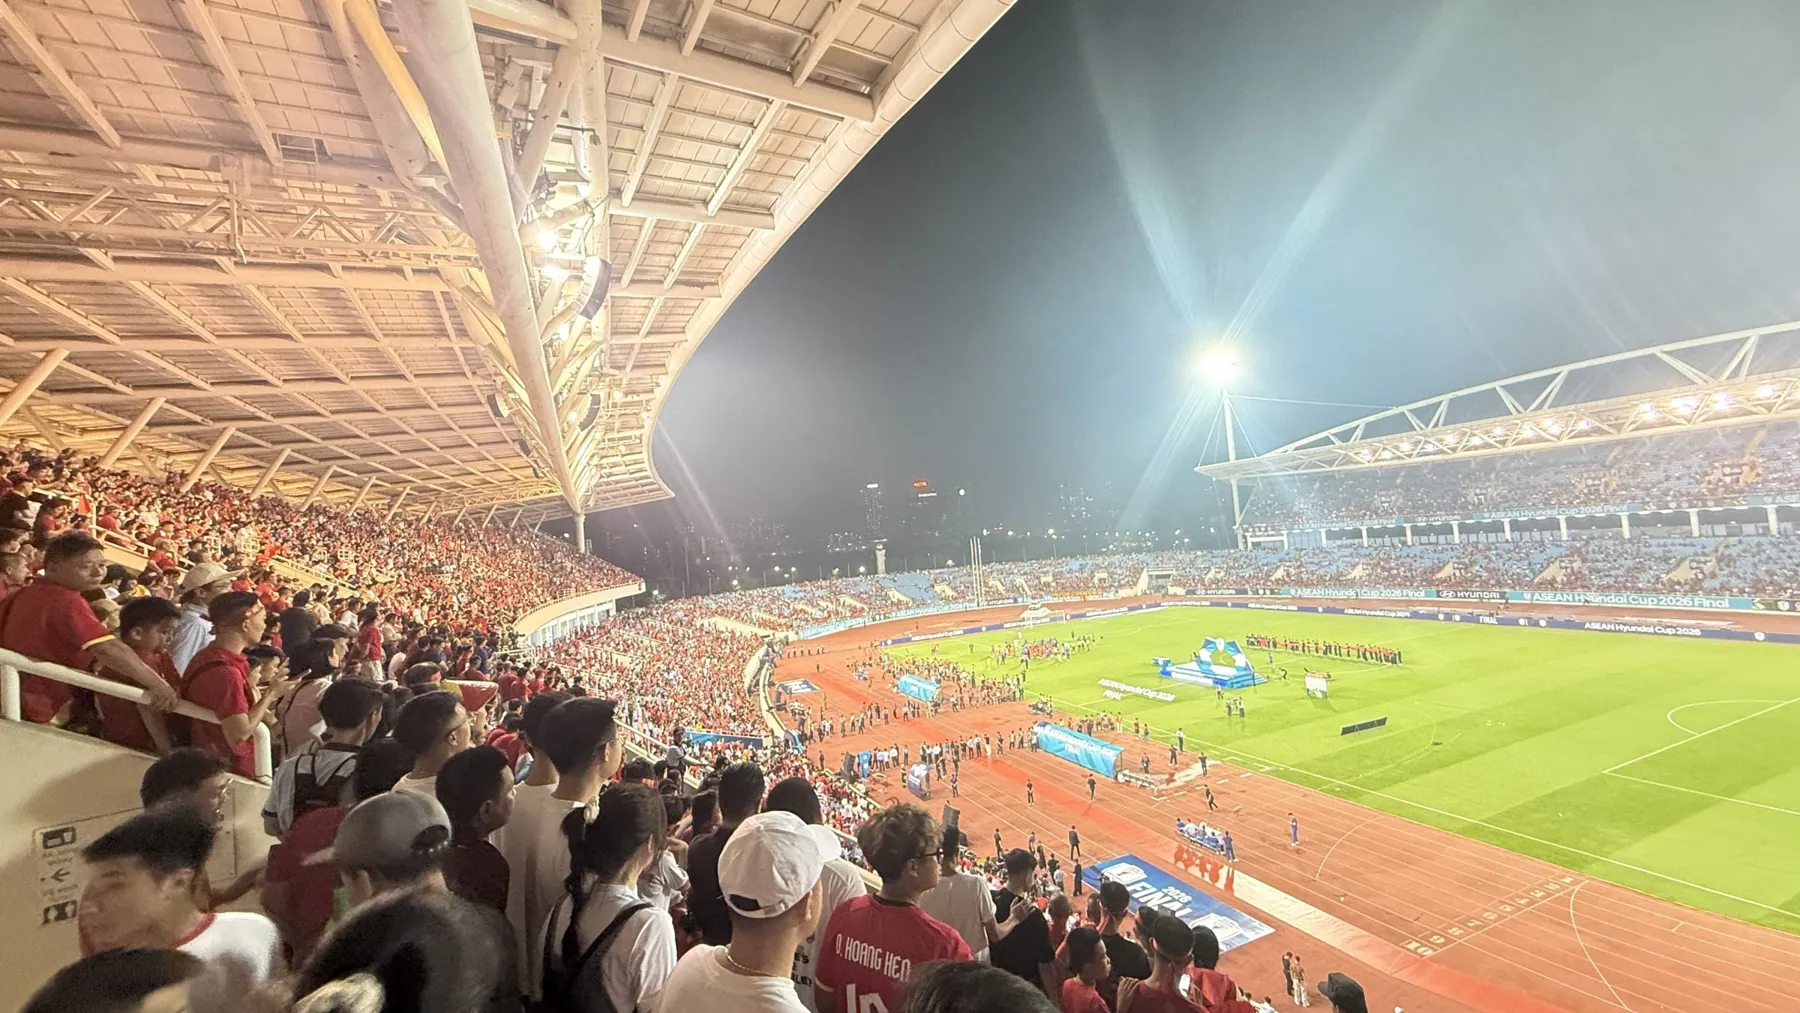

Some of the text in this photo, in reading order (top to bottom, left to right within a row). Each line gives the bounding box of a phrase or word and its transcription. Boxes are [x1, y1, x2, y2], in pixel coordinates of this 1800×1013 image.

[1429, 514, 1461, 522] HYUNDAI
[1490, 510, 1519, 519] ASEAN
[1559, 507, 1578, 517] Cup
[1580, 505, 1603, 514] 2026
[1296, 588, 1324, 596] ASEAN
[1361, 589, 1379, 598] Cup
[1381, 589, 1402, 597] 2026
[1403, 589, 1425, 598] Final
[1457, 591, 1500, 599] HYUNDAI
[1533, 592, 1573, 602] ASEAN
[1628, 595, 1657, 607] Cup
[1659, 596, 1693, 607] 2026
[1694, 597, 1730, 608] Final
[1584, 621, 1614, 631] ASEAN
[1615, 623, 1654, 633] Hyundai
[1654, 626, 1676, 635] Cup
[1161, 885, 1193, 904] 2026
[1402, 939, 1434, 957] 10
